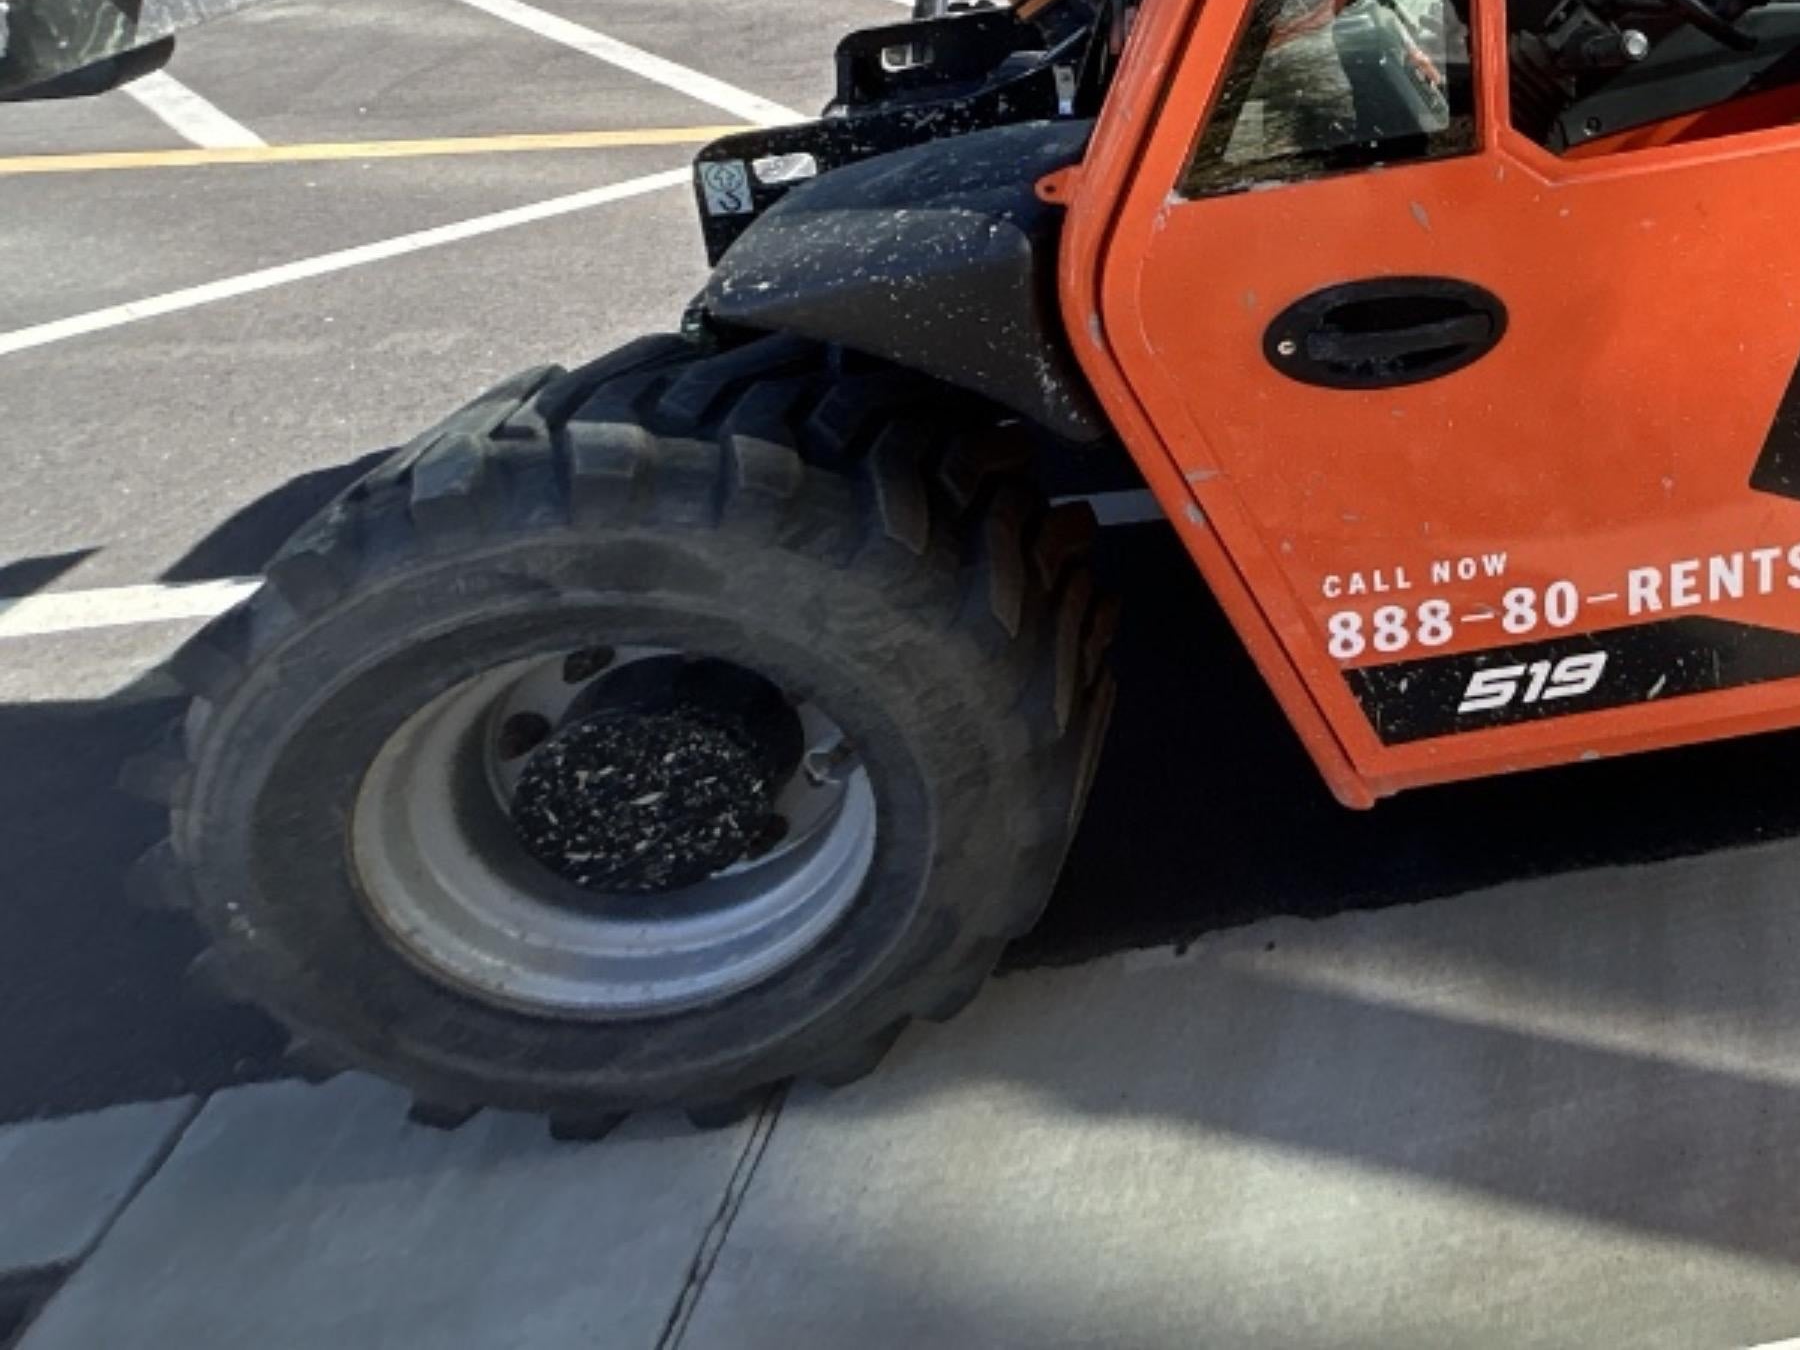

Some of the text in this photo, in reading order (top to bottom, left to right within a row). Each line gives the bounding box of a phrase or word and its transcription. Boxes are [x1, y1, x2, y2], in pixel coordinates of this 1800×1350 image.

[1322, 551, 1510, 599] CALL NOW
[1457, 651, 1607, 713] 519
